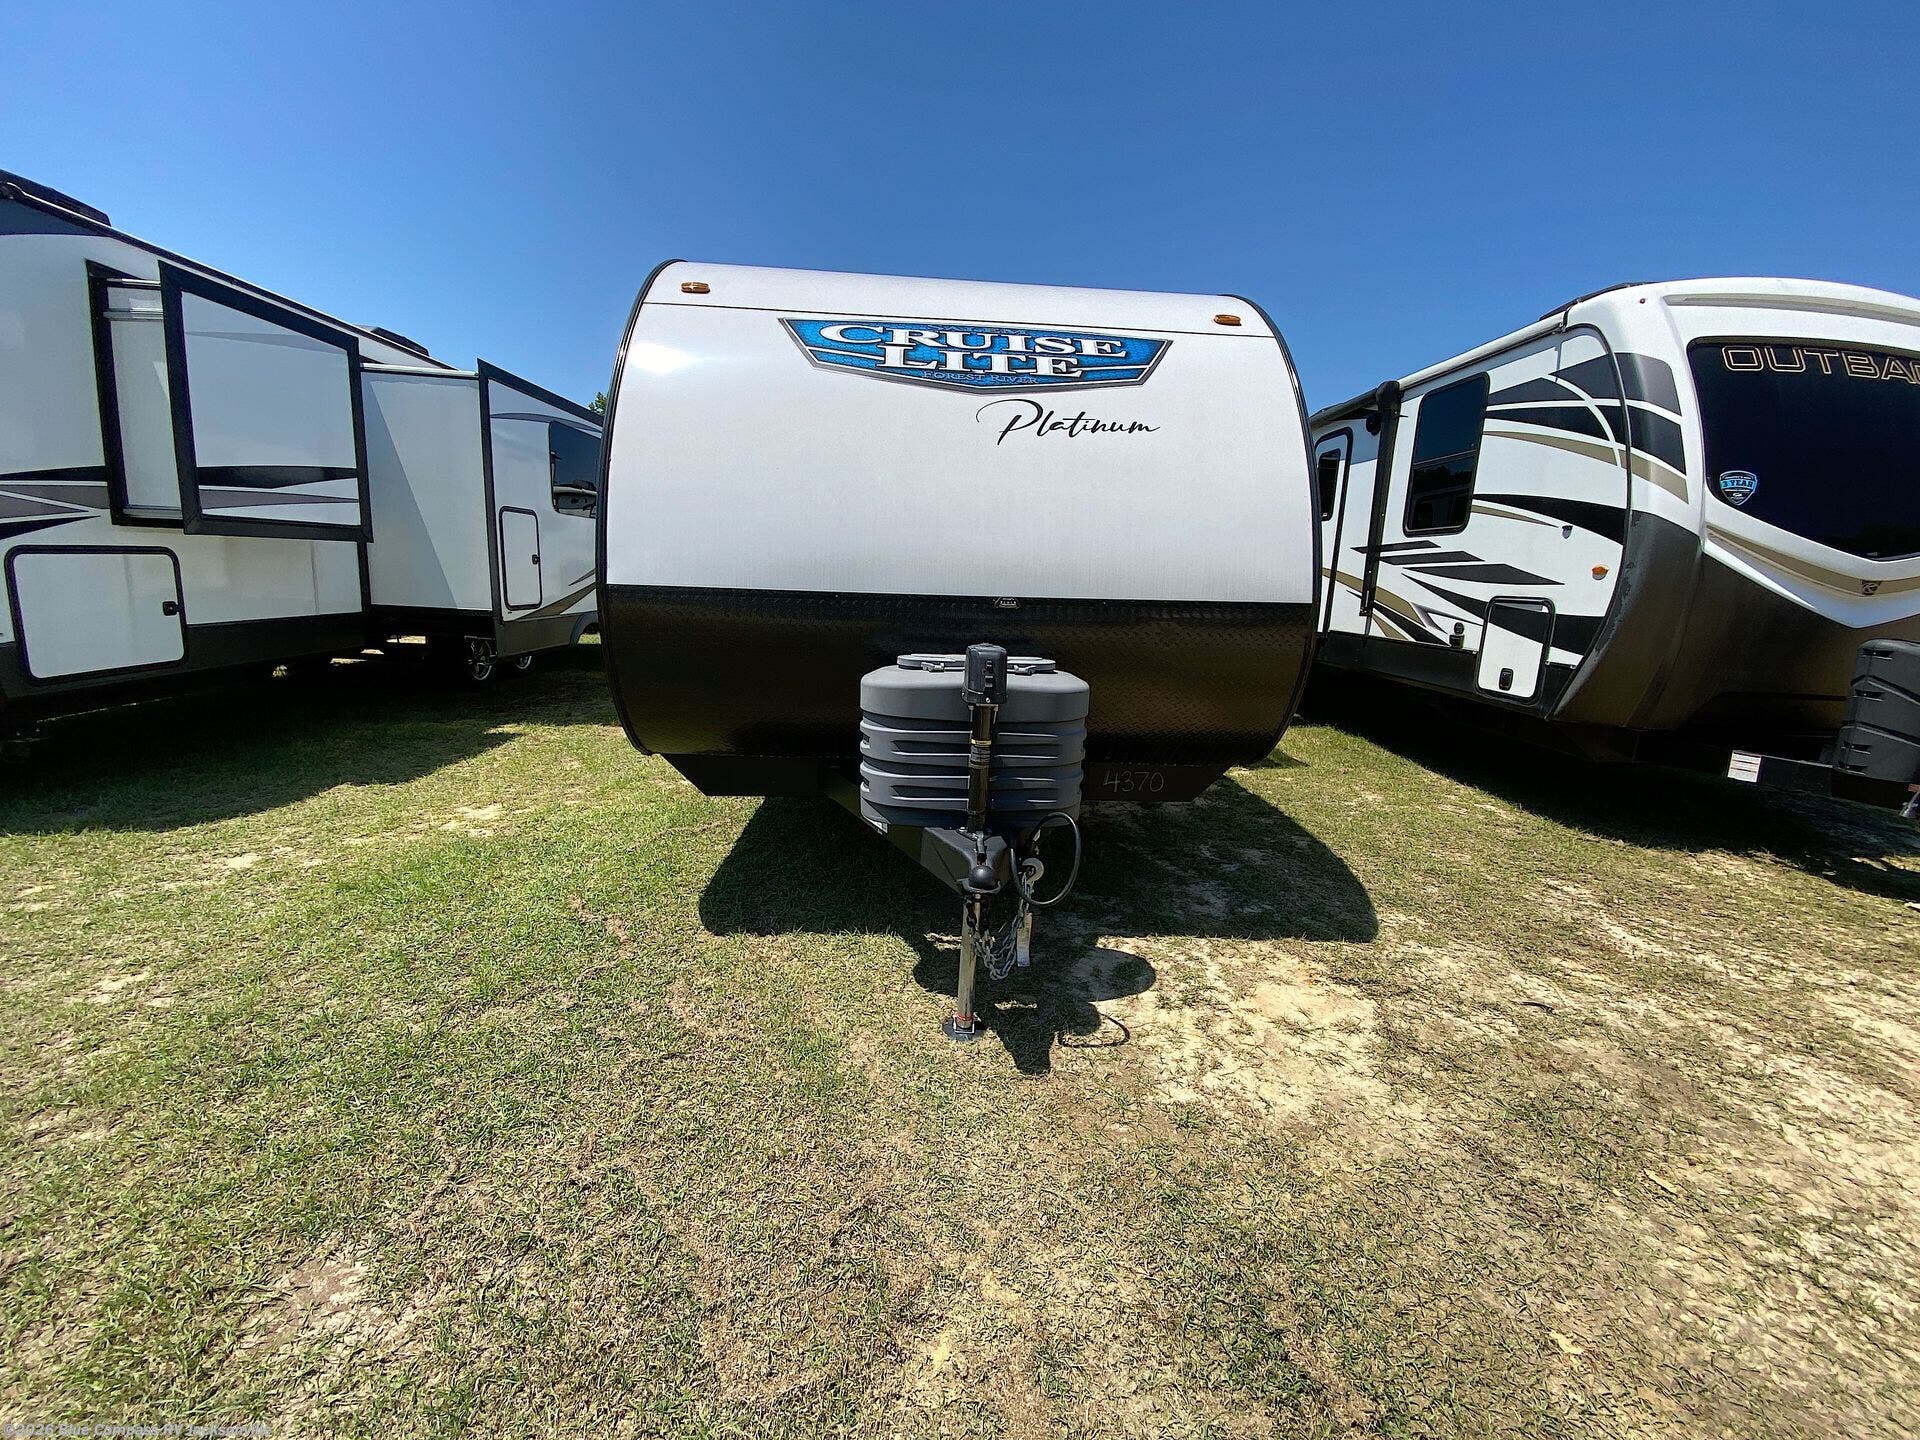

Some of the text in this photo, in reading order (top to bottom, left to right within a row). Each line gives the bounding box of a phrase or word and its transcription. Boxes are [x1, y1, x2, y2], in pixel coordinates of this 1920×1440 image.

[820, 324, 1126, 357] CRUISE
[876, 345, 1082, 377] LITE
[1722, 346, 1920, 384] OUTBA
[922, 371, 1038, 384] FOREST RIVER
[976, 398, 1161, 446] Platinum
[1729, 480, 1754, 489] YEAR
[1102, 769, 1164, 793] 4370
